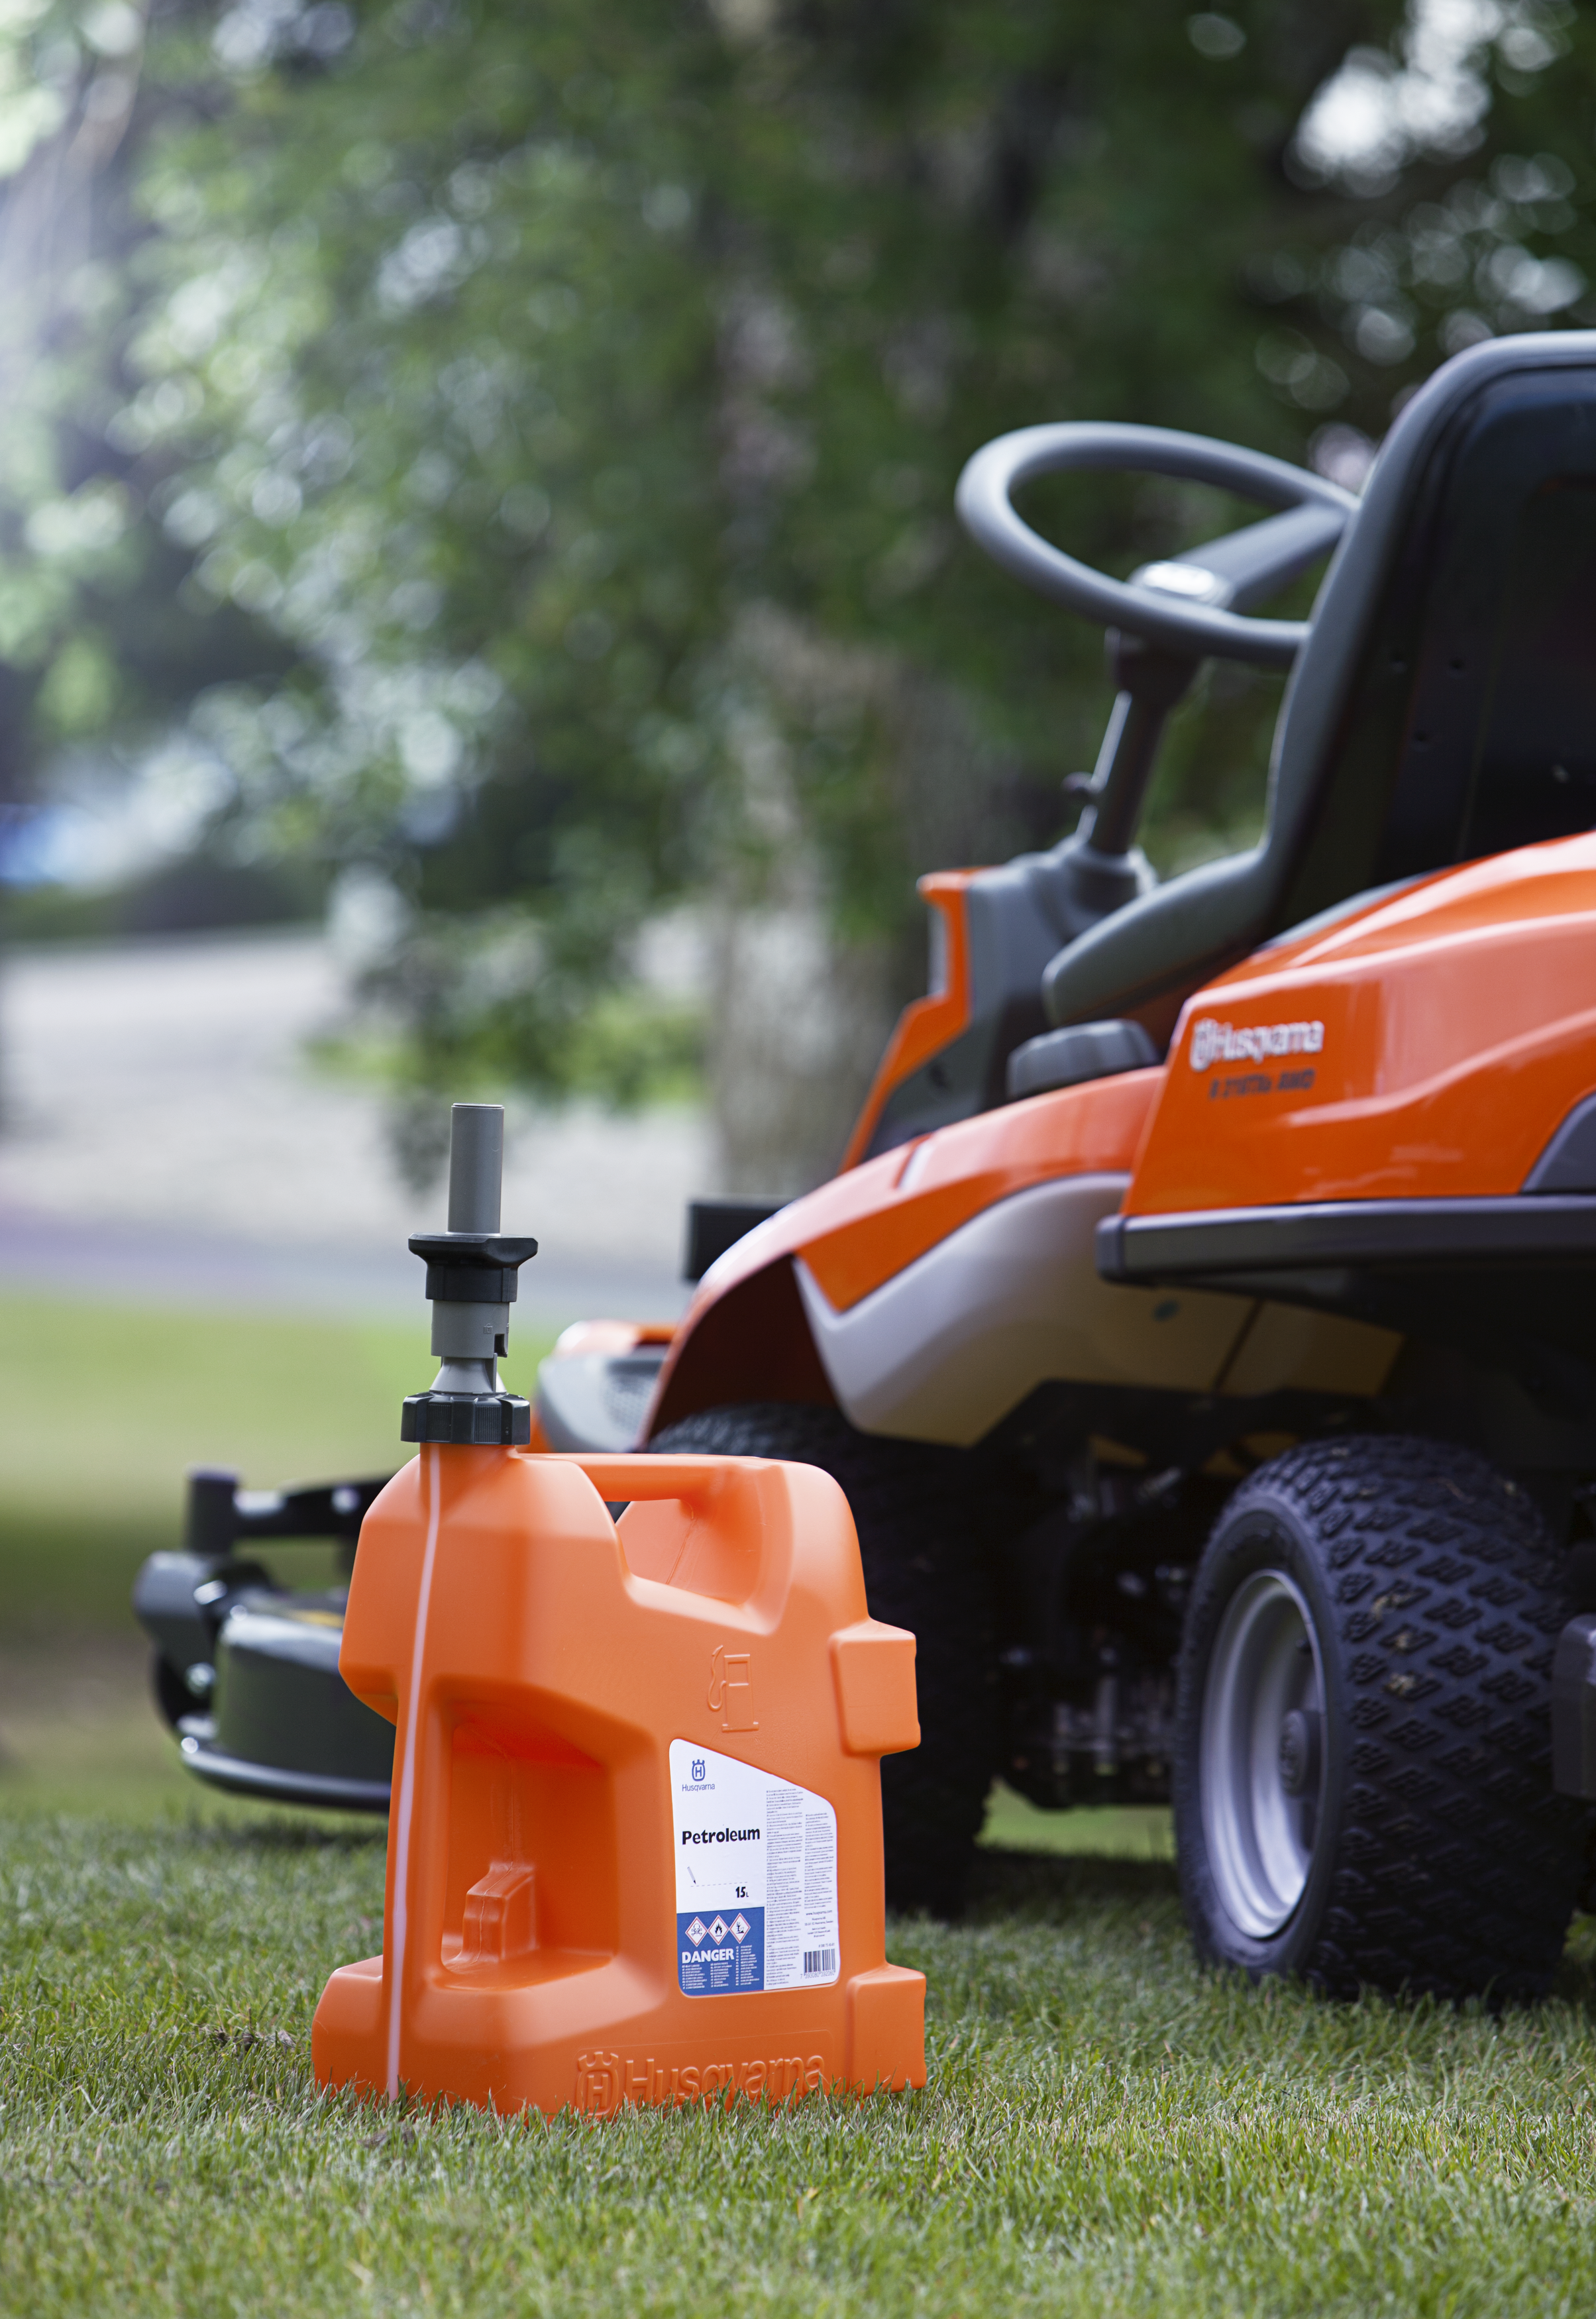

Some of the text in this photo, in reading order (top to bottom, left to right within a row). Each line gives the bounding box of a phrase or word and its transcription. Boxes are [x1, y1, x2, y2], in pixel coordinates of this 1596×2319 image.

[682, 1828, 760, 1845] Petroleum
[682, 1948, 735, 1964] DANGER
[625, 2055, 825, 2107] Husqvarna
